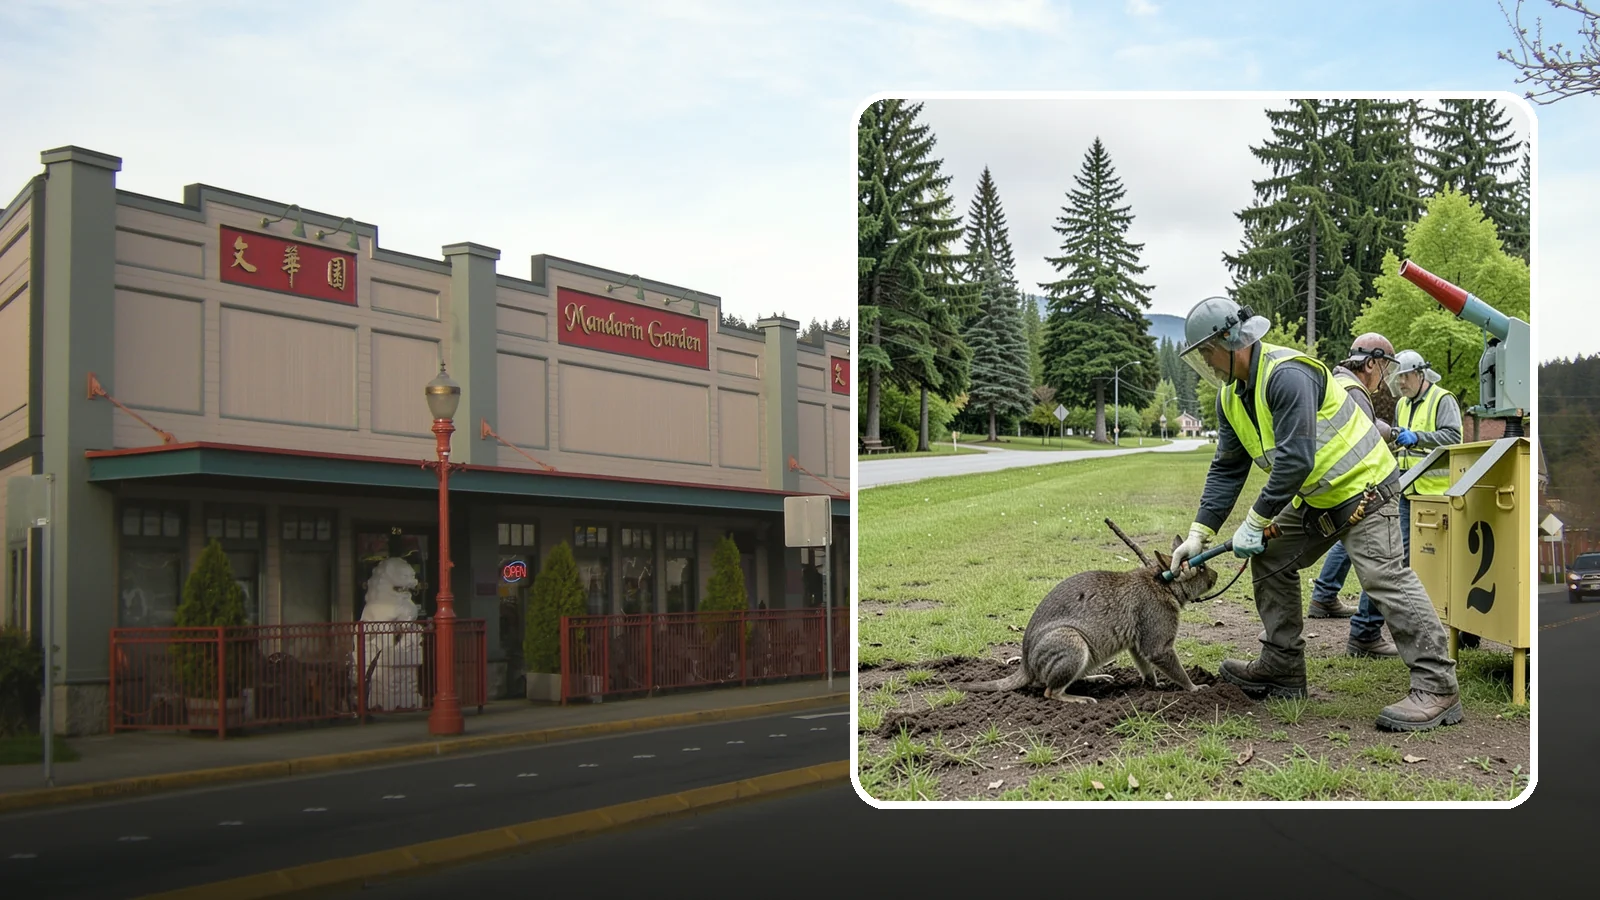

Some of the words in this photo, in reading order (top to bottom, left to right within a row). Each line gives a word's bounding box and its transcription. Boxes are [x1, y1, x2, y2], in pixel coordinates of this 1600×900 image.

[231, 236, 346, 291] 文華園
[564, 302, 644, 340] Mandarin
[647, 320, 702, 352] Garden
[503, 565, 527, 578] OPEN
[1467, 520, 1496, 614] 2
